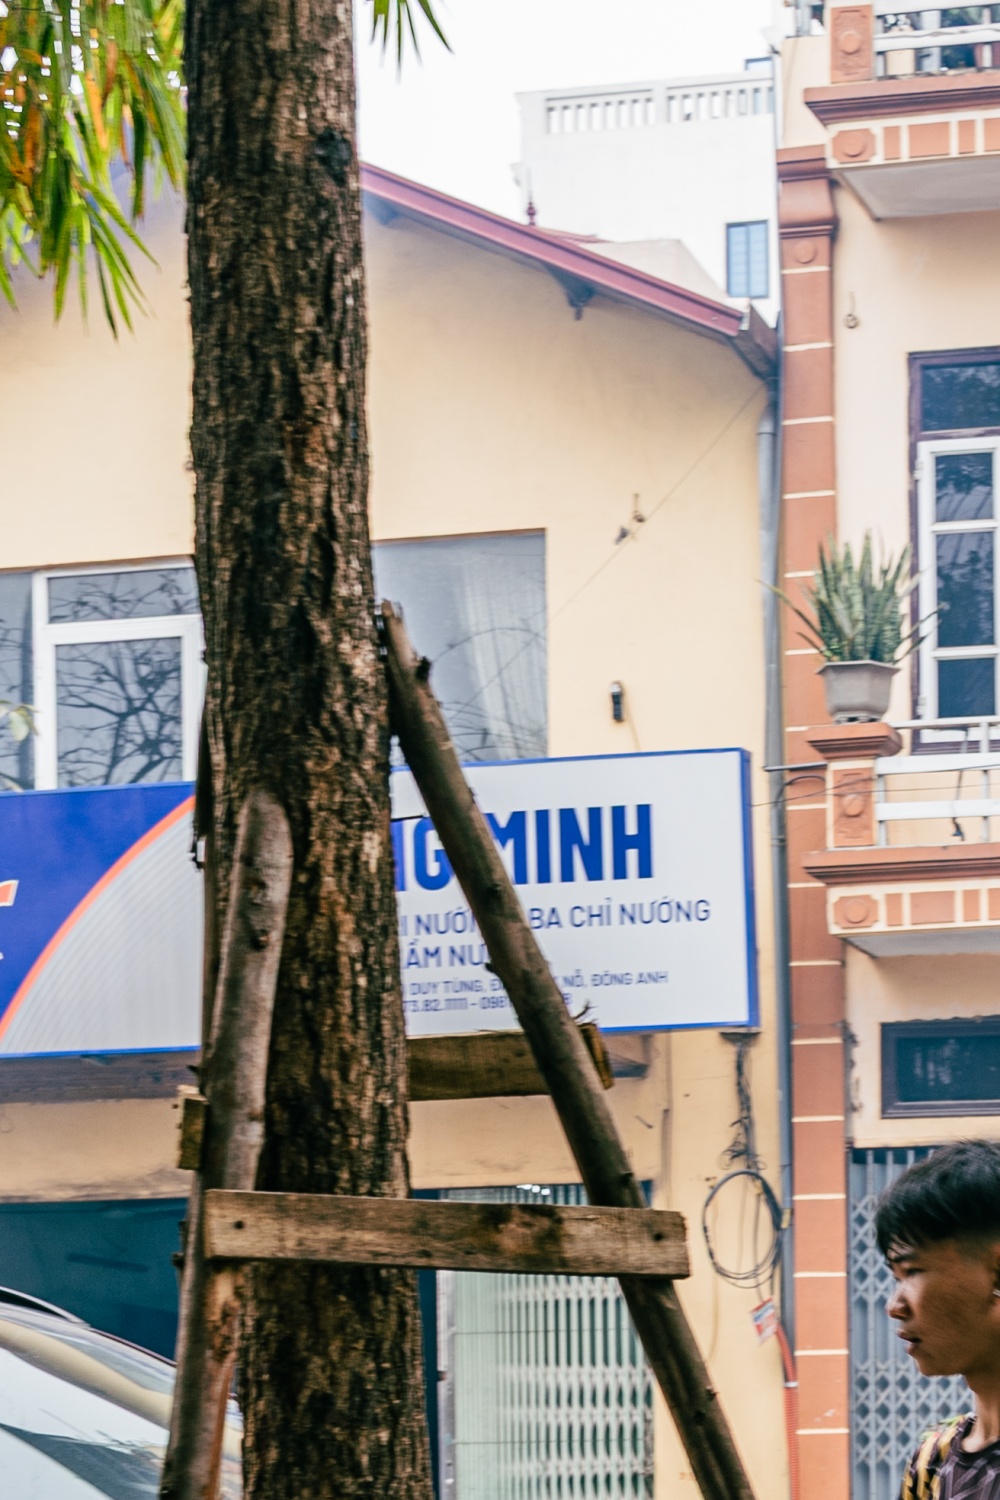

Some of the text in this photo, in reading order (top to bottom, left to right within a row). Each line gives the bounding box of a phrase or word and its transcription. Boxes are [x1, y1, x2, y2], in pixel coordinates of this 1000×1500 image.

[484, 804, 653, 886] MINH
[529, 907, 563, 930] BA
[569, 897, 611, 927] CHỈ
[618, 895, 711, 926] NƯỚNG
